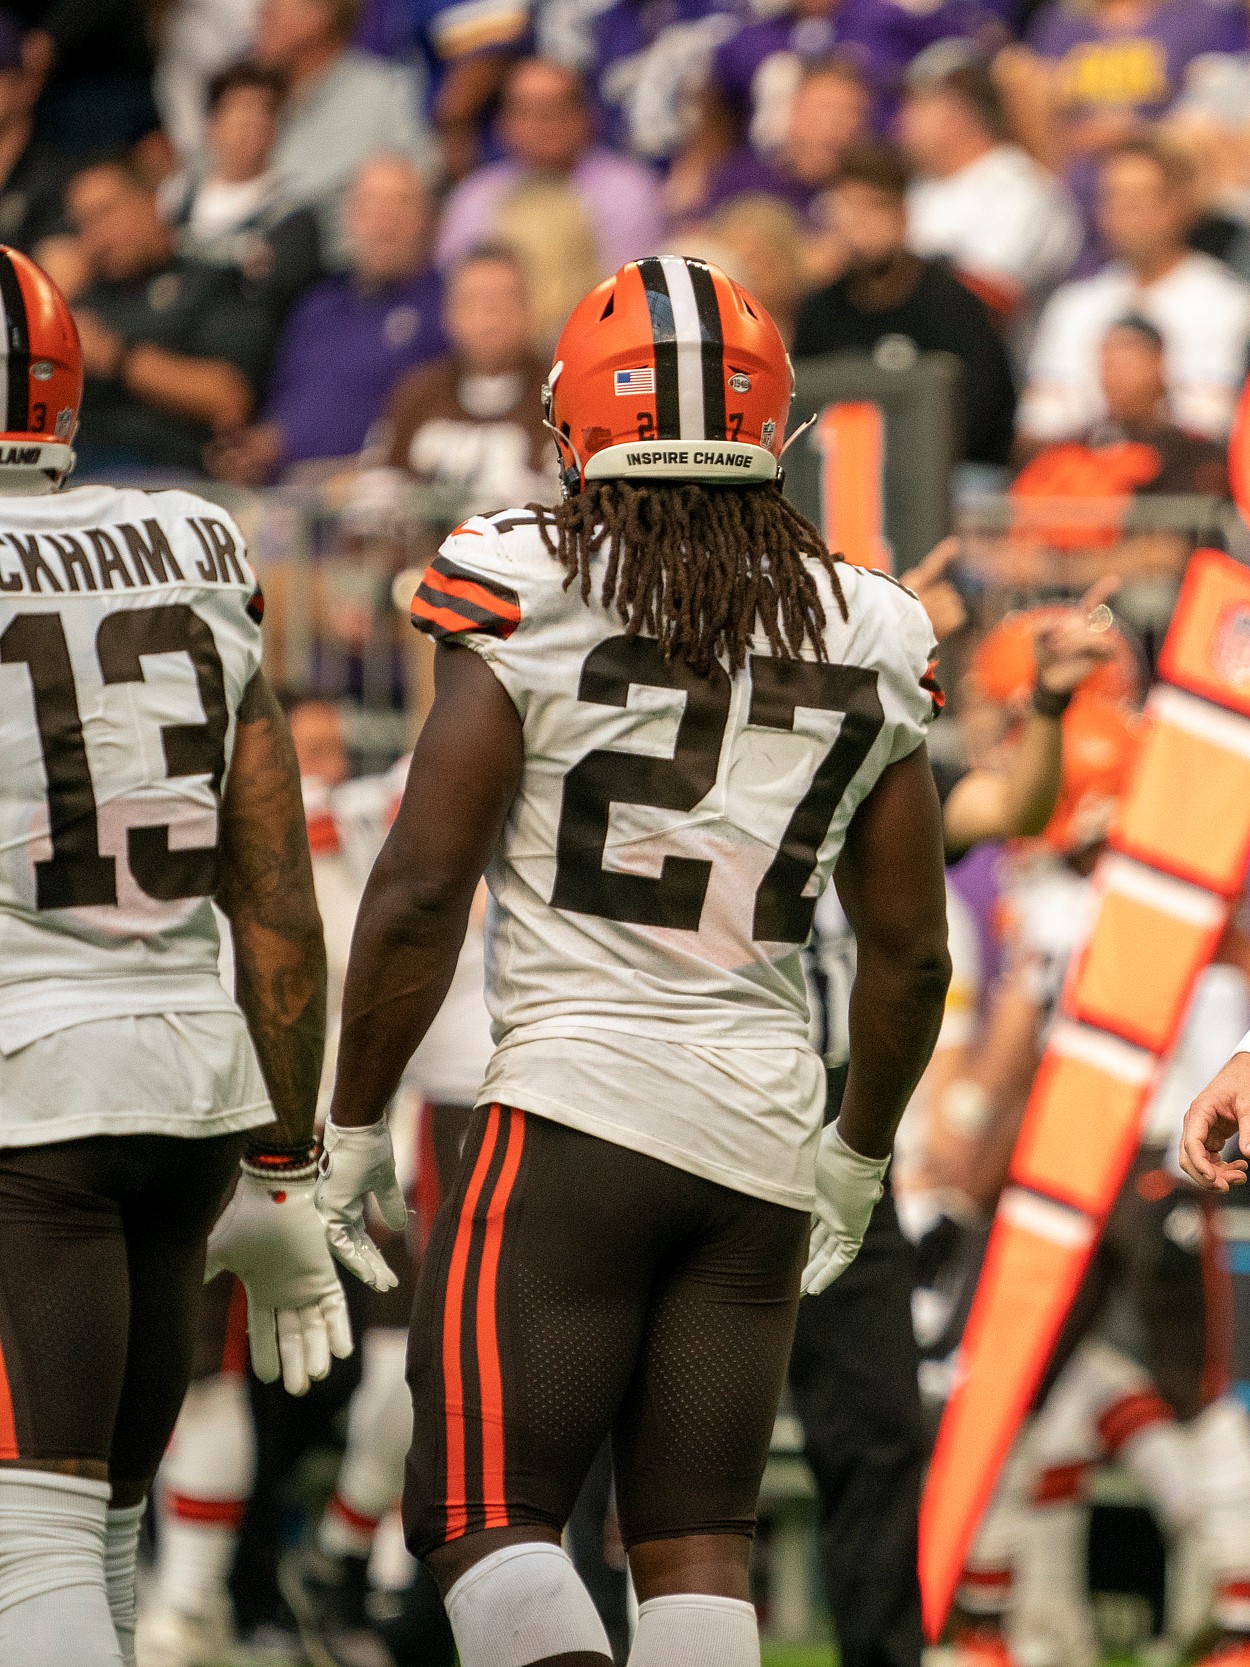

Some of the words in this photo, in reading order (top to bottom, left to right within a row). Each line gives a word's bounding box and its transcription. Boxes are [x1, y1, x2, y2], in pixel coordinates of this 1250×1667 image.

[732, 378, 748, 389] 1946
[627, 452, 688, 466] INSPIRE
[694, 451, 753, 468] CHANGE
[186, 517, 245, 584] JR
[0, 603, 228, 910] 13
[550, 634, 884, 943] 27
